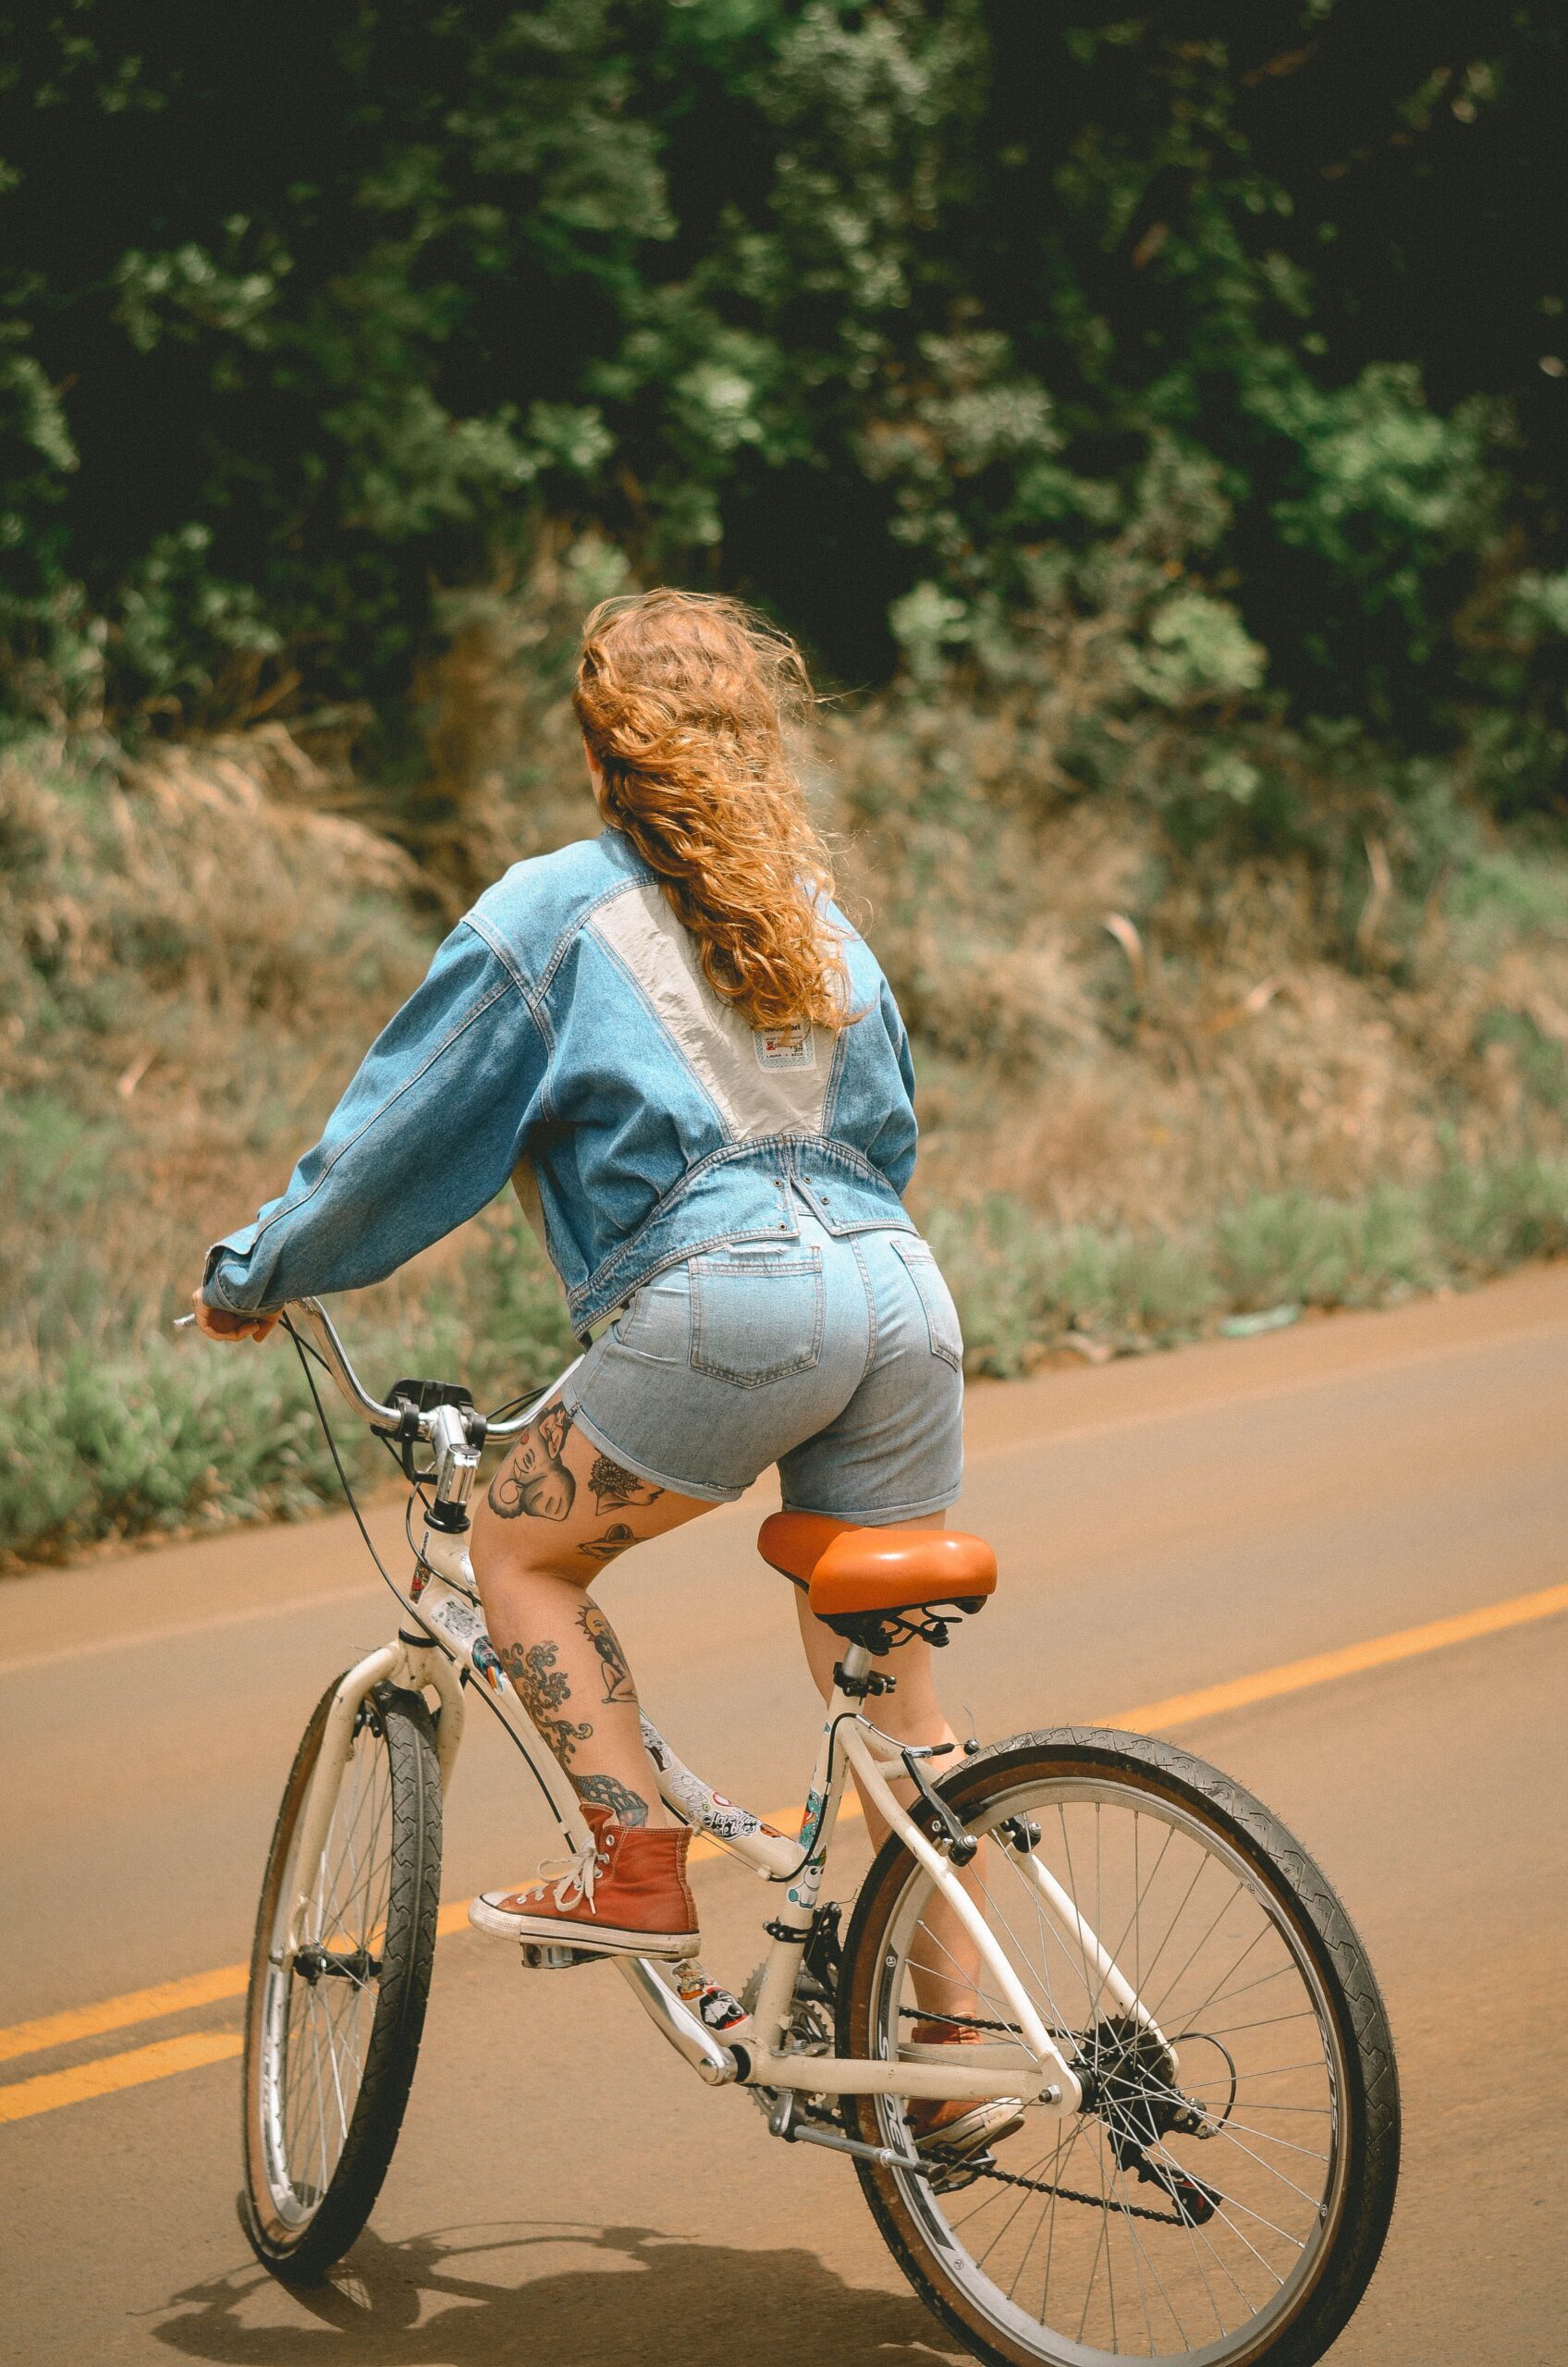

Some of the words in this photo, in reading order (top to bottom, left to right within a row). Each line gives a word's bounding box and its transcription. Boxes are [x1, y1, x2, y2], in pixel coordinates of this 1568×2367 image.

[703, 1811, 738, 1828] Have
[729, 1821, 756, 1835] bikes
[878, 2020, 905, 2149] SDE
